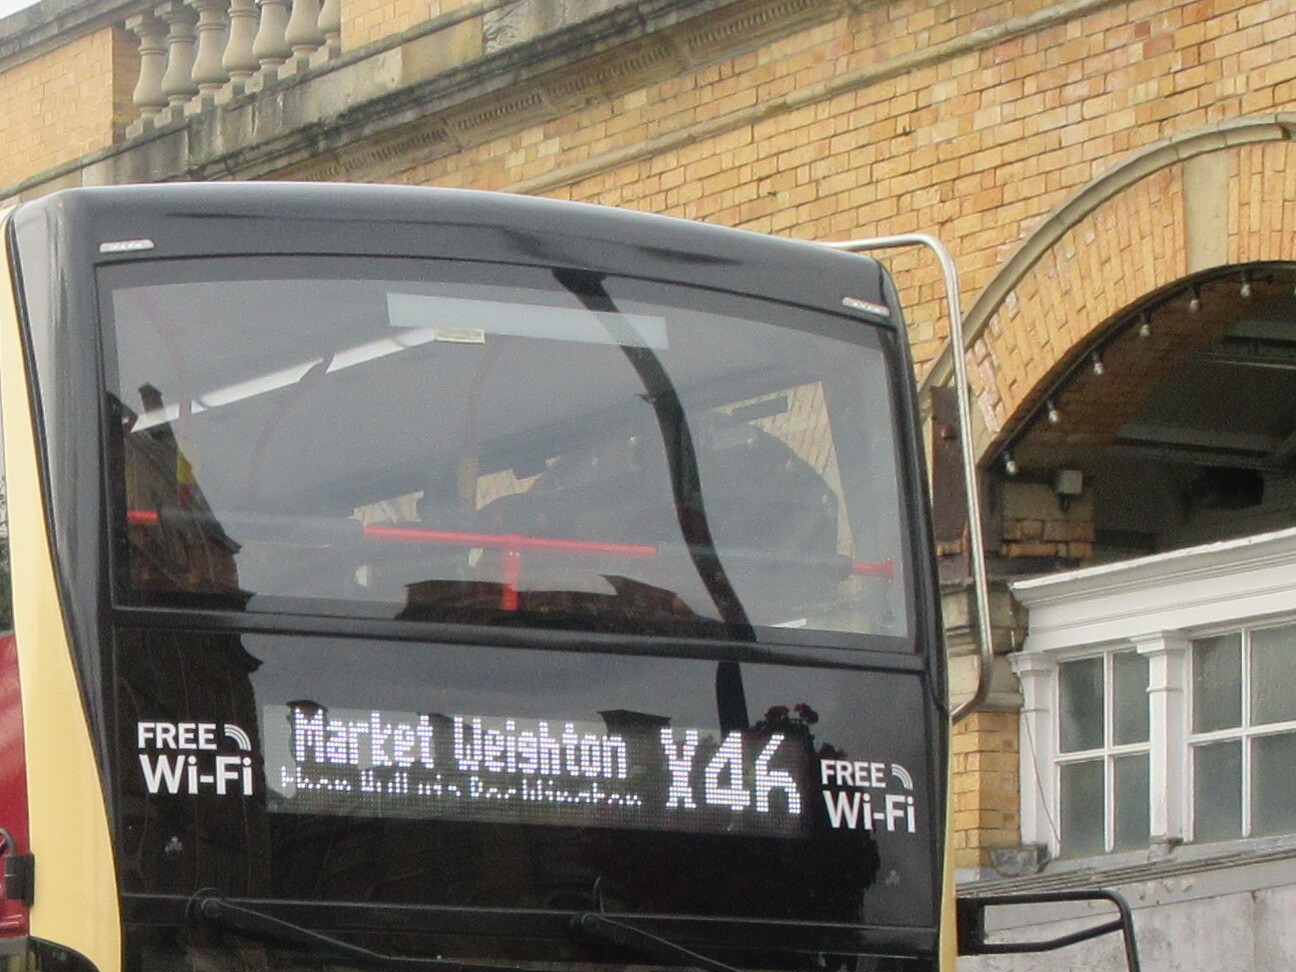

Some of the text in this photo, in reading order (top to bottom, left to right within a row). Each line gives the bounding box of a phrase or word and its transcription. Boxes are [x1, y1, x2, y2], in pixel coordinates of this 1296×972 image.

[137, 722, 217, 750] FREE
[295, 707, 626, 778] Market Weighton
[139, 754, 253, 796] Wi-Fi
[660, 728, 801, 814] X46
[820, 759, 886, 788] FREE
[822, 790, 916, 833] Wi-Fi
